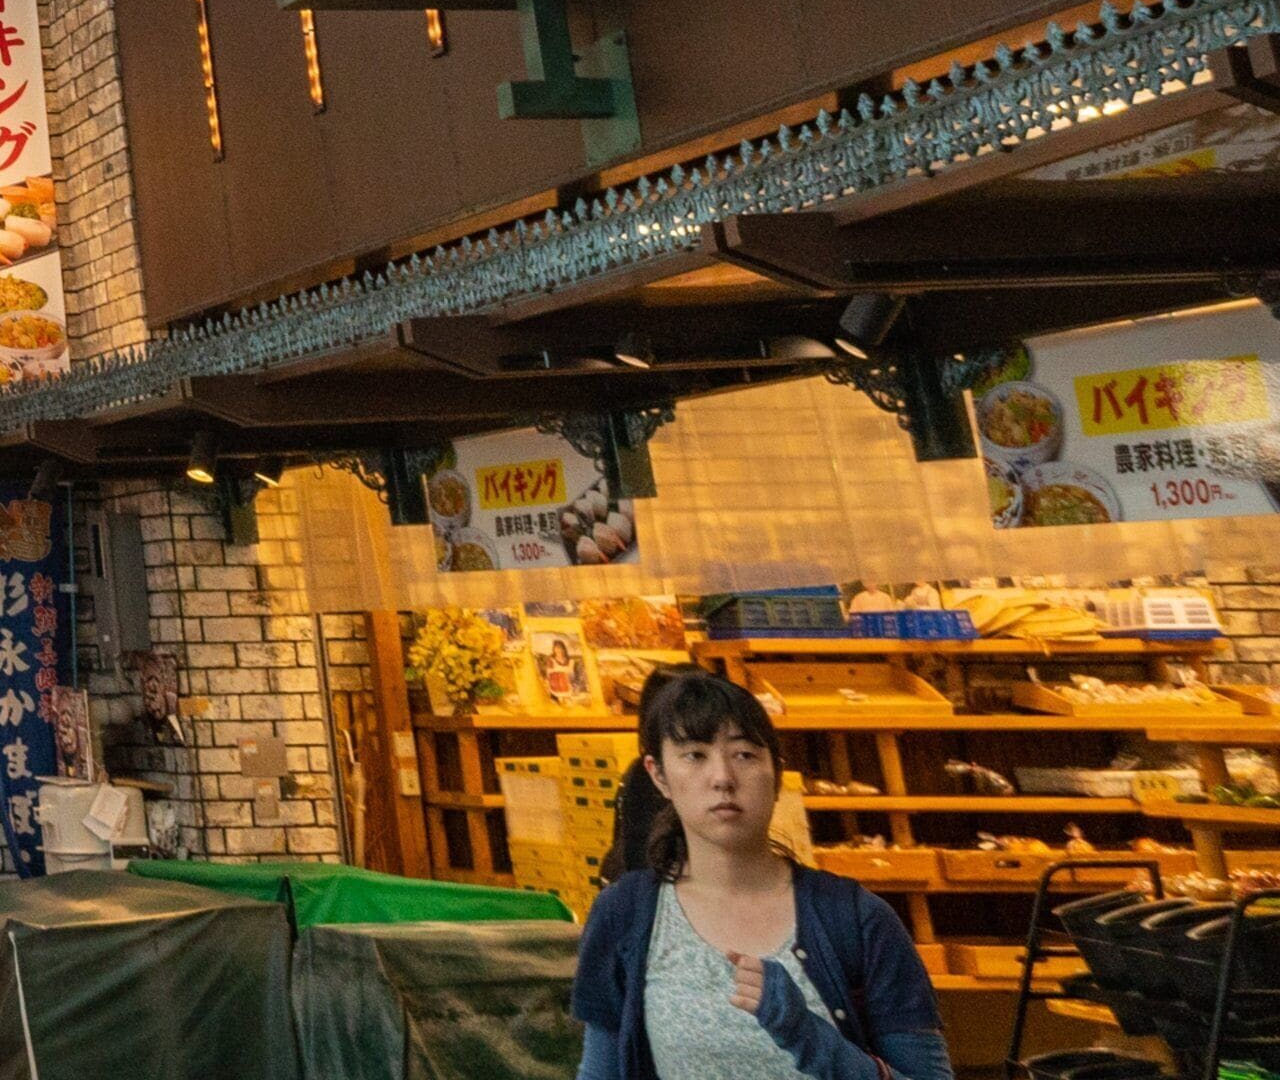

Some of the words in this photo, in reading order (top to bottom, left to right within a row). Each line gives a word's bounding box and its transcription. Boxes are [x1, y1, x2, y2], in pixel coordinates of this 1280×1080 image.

[483, 461, 558, 503] バイキング
